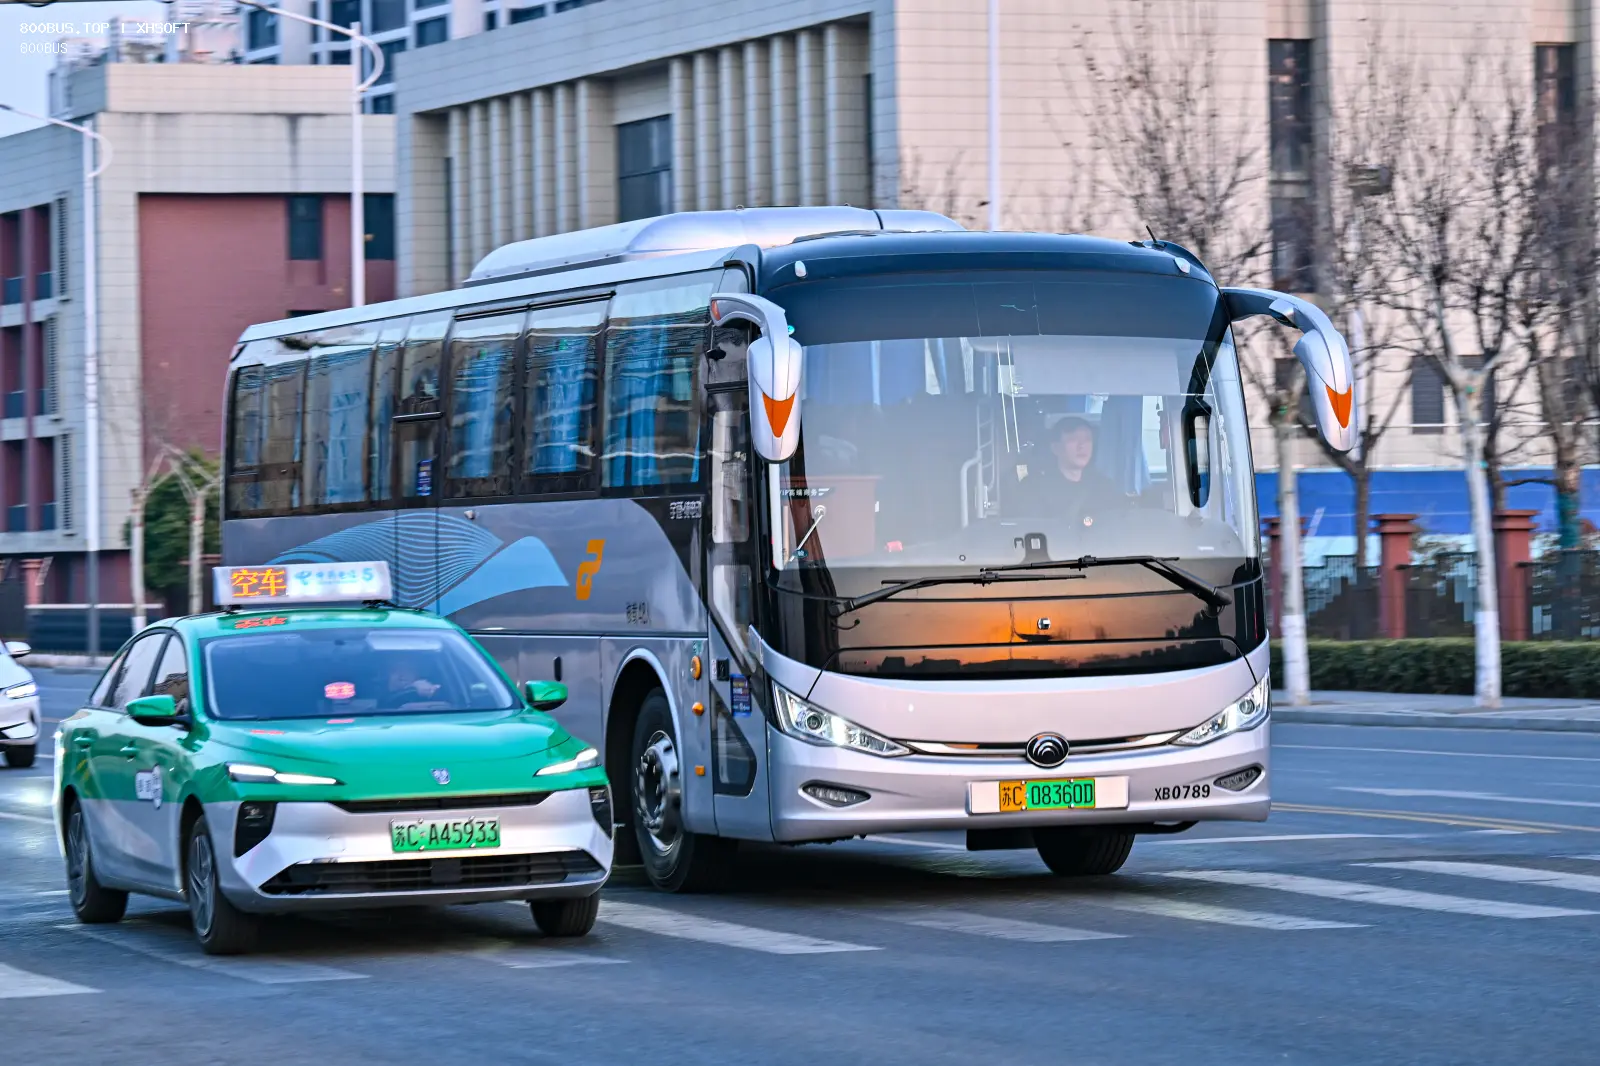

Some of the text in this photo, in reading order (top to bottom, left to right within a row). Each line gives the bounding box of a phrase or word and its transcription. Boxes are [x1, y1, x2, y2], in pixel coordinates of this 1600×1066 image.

[231, 568, 287, 597] 空车
[1001, 782, 1094, 807] 苏C 08360D
[1154, 784, 1211, 801] XB0789
[429, 820, 498, 845] A45933
